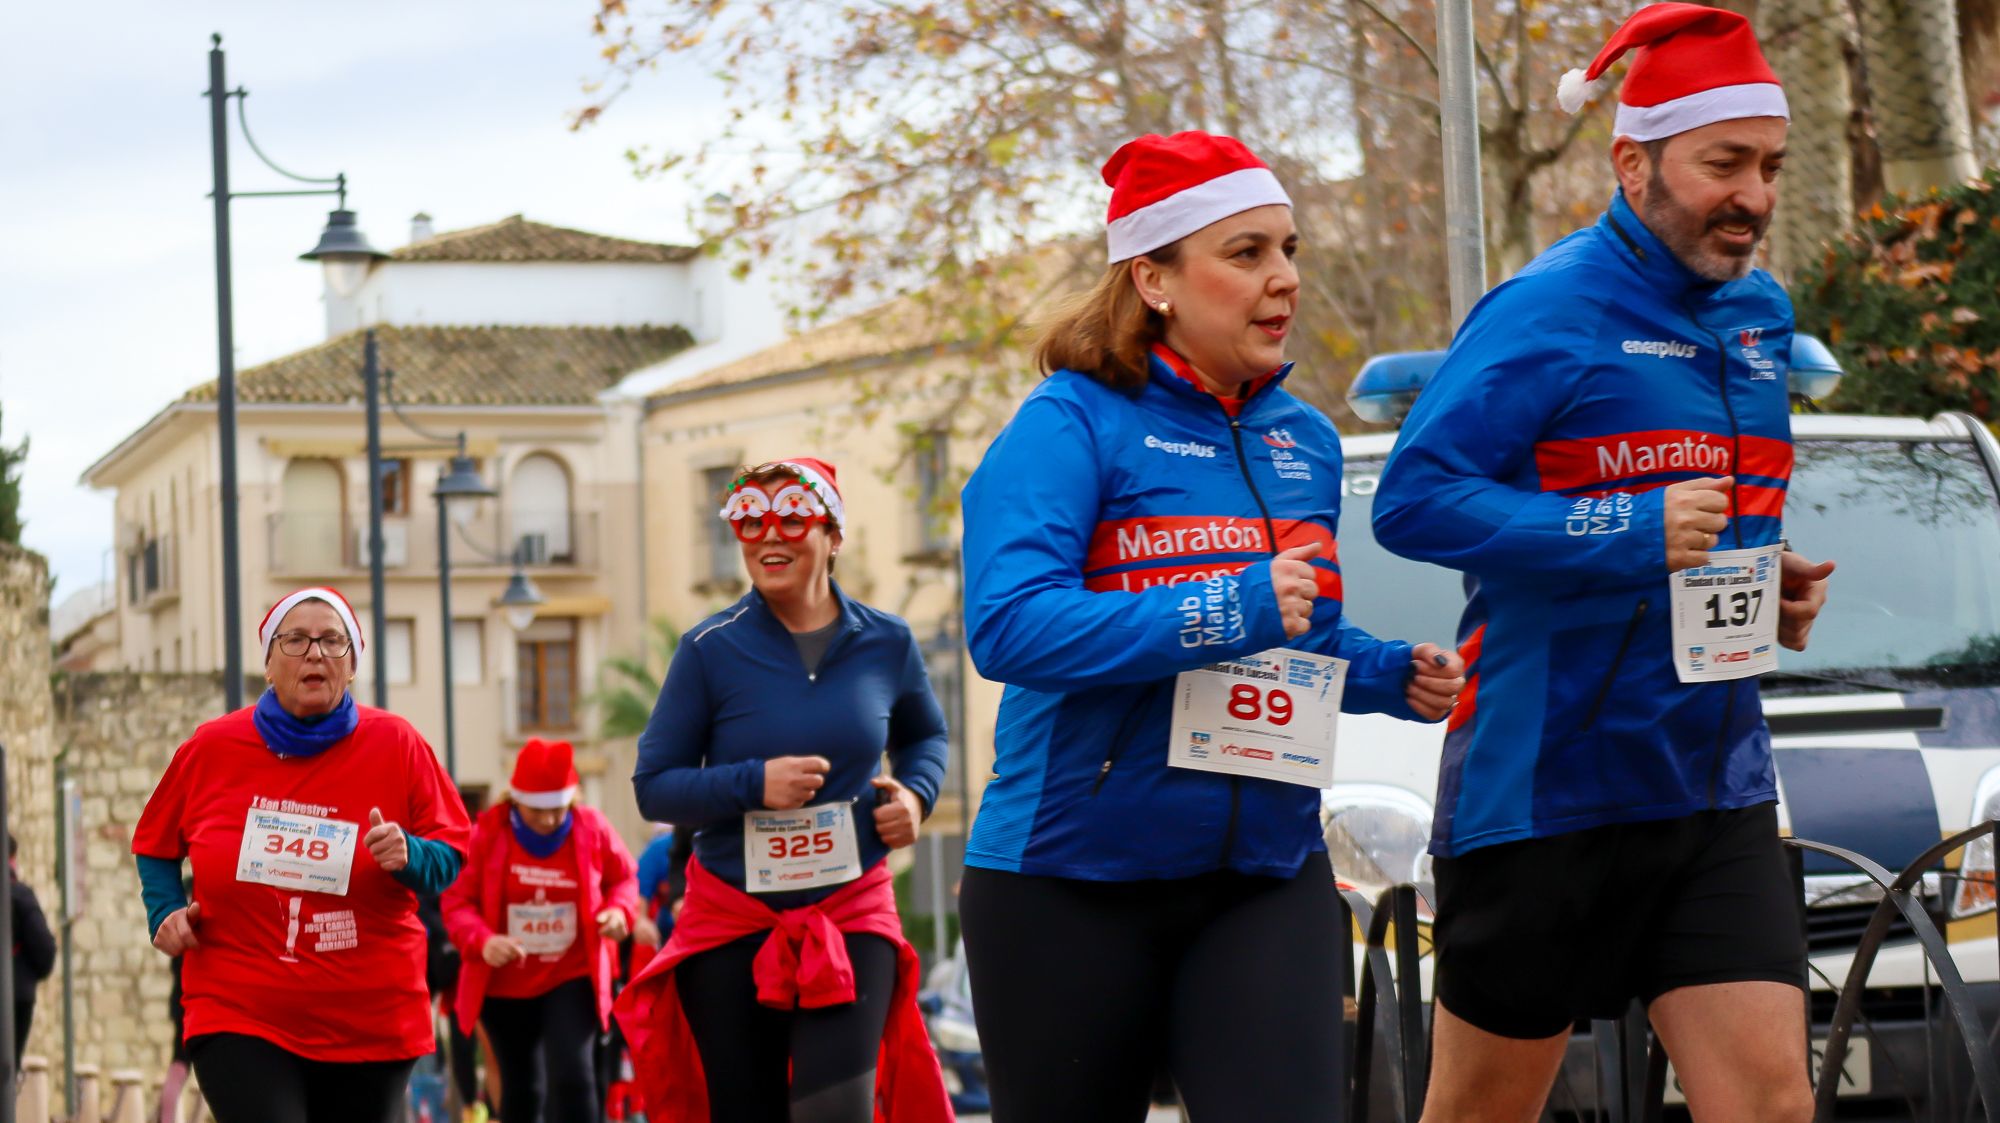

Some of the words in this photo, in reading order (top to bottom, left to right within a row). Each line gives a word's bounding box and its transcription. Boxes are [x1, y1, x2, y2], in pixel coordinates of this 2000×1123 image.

[1621, 339, 1698, 359] enerplus
[1144, 435, 1216, 458] enerplus
[1270, 449, 1294, 460] Club
[1596, 434, 1729, 478] Maratón
[1276, 470, 1313, 480] Lucena
[1565, 497, 1594, 537] Club
[1117, 518, 1262, 560] Maratón
[1704, 588, 1764, 629] 137
[1177, 596, 1203, 648] Club
[1232, 665, 1244, 676] de
[1246, 667, 1279, 681] Lucena
[1227, 682, 1293, 726] 89
[259, 797, 280, 812] San
[280, 800, 328, 817] Silvestre
[263, 834, 330, 862] 348
[768, 831, 834, 859] 325
[312, 910, 355, 923] MEMORIAL
[325, 919, 356, 932] CARLOS
[319, 929, 358, 942] HURTADO
